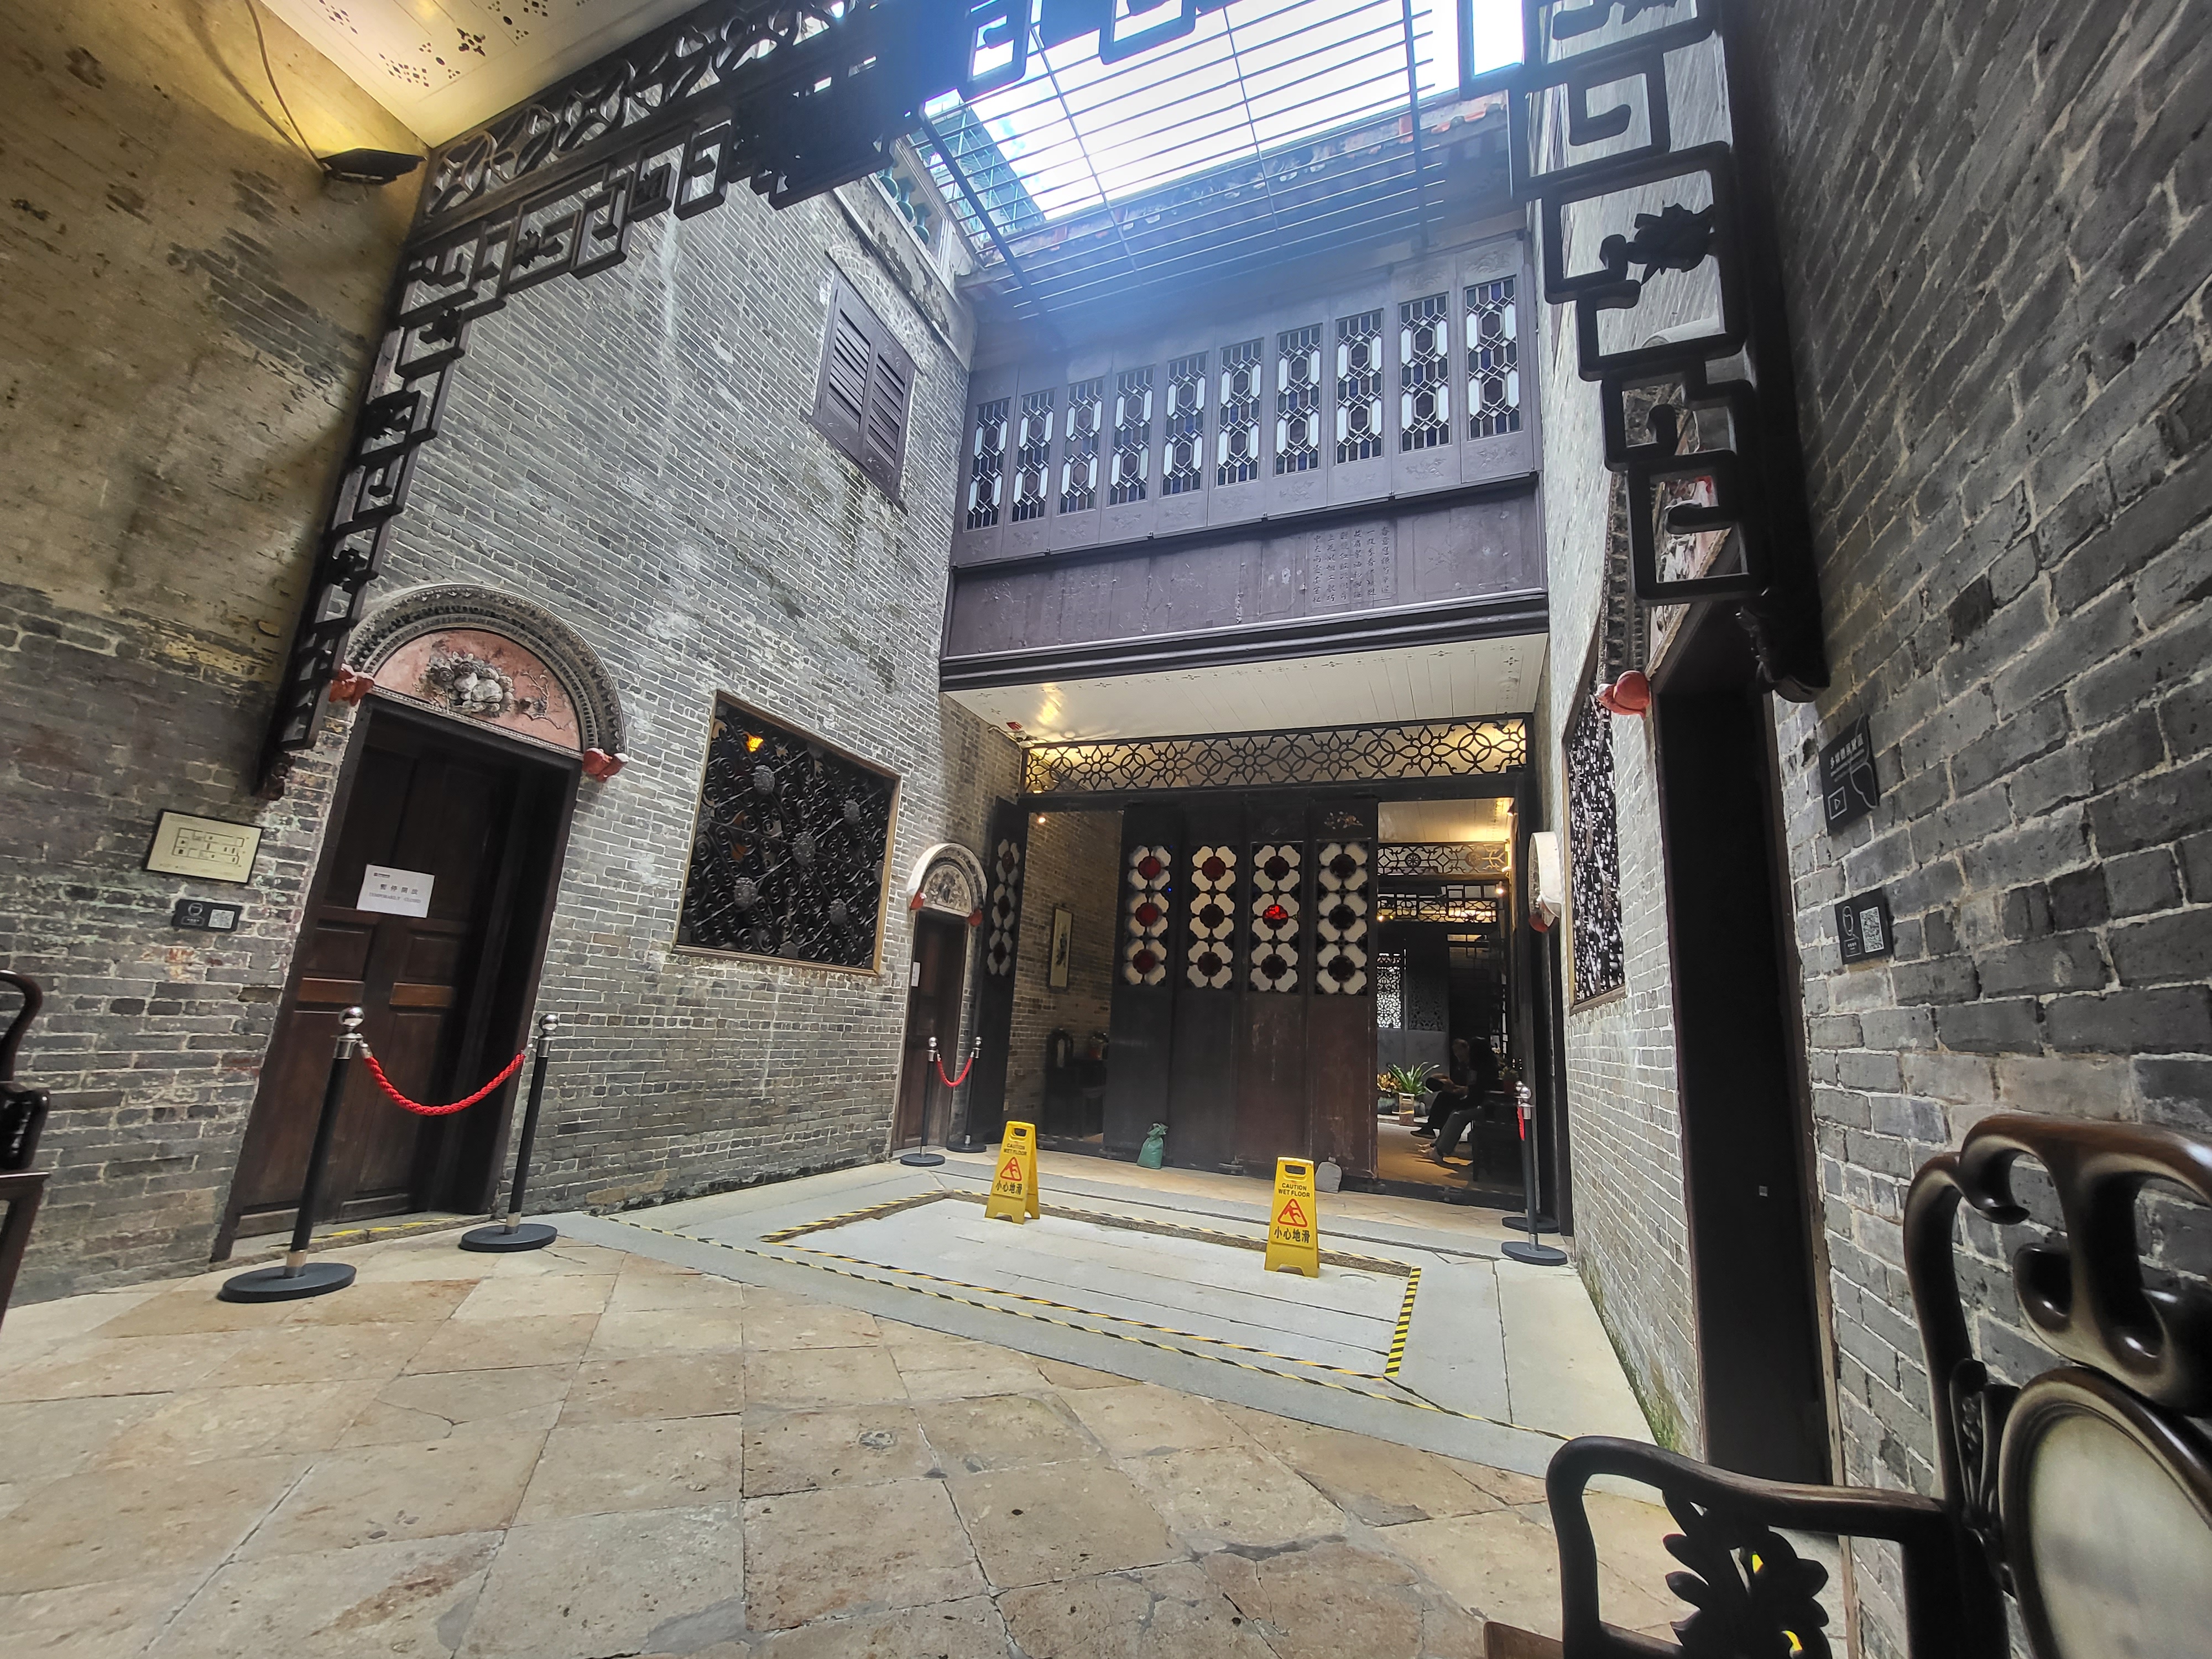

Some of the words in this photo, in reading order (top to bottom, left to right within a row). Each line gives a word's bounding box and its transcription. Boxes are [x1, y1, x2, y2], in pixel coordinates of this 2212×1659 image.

[995, 1181, 1022, 1195] 小心地滑
[1282, 1182, 1307, 1191] CAUTION
[1291, 1190, 1311, 1198] FLOOR
[1274, 1225, 1311, 1244] 小心地滑
